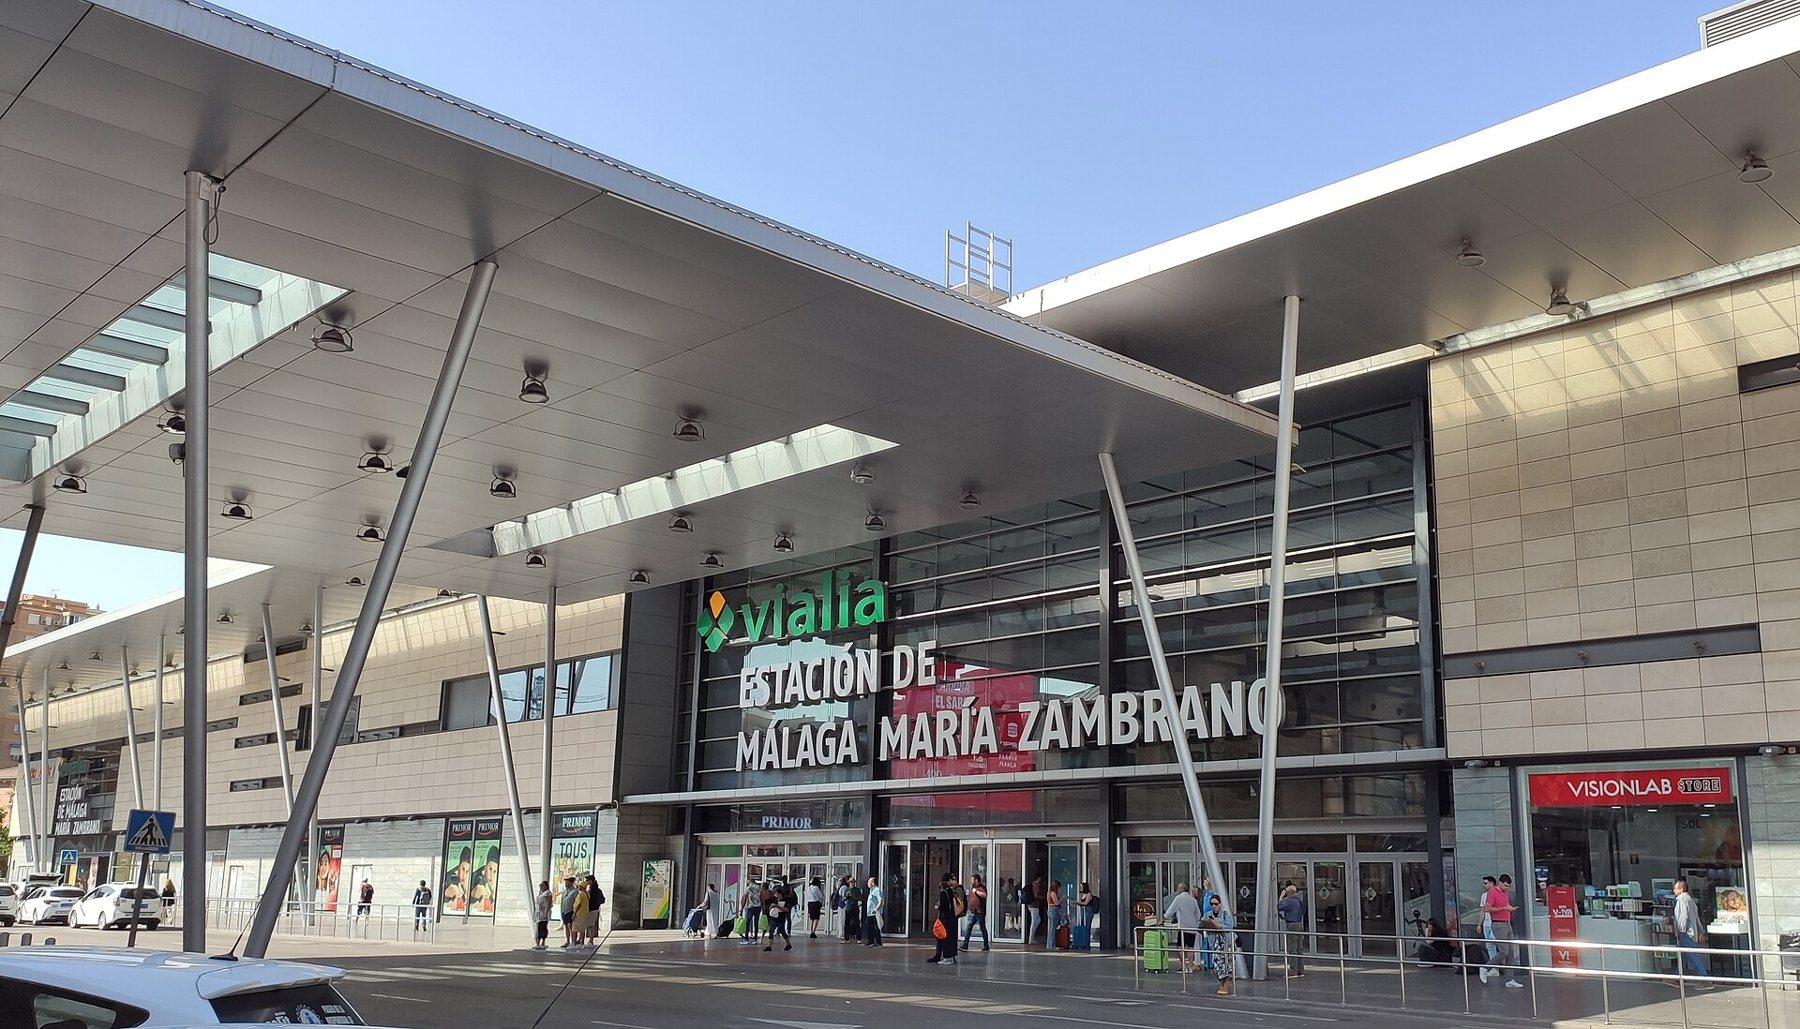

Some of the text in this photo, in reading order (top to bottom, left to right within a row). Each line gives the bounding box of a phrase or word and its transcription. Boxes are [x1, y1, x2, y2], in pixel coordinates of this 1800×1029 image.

[741, 570, 887, 641] vialia
[739, 640, 937, 709] ESTACIÓN DE
[736, 677, 1286, 771] MÁLAGA MARÍA ZAMBRANO
[1567, 777, 1721, 798] VISIONLAB STORE
[452, 823, 472, 832] PRIMOR
[478, 822, 499, 831] PRIMOR
[562, 816, 592, 828] PRIMOR
[761, 815, 812, 829] PRIMOR
[559, 842, 588, 858] TOUS
